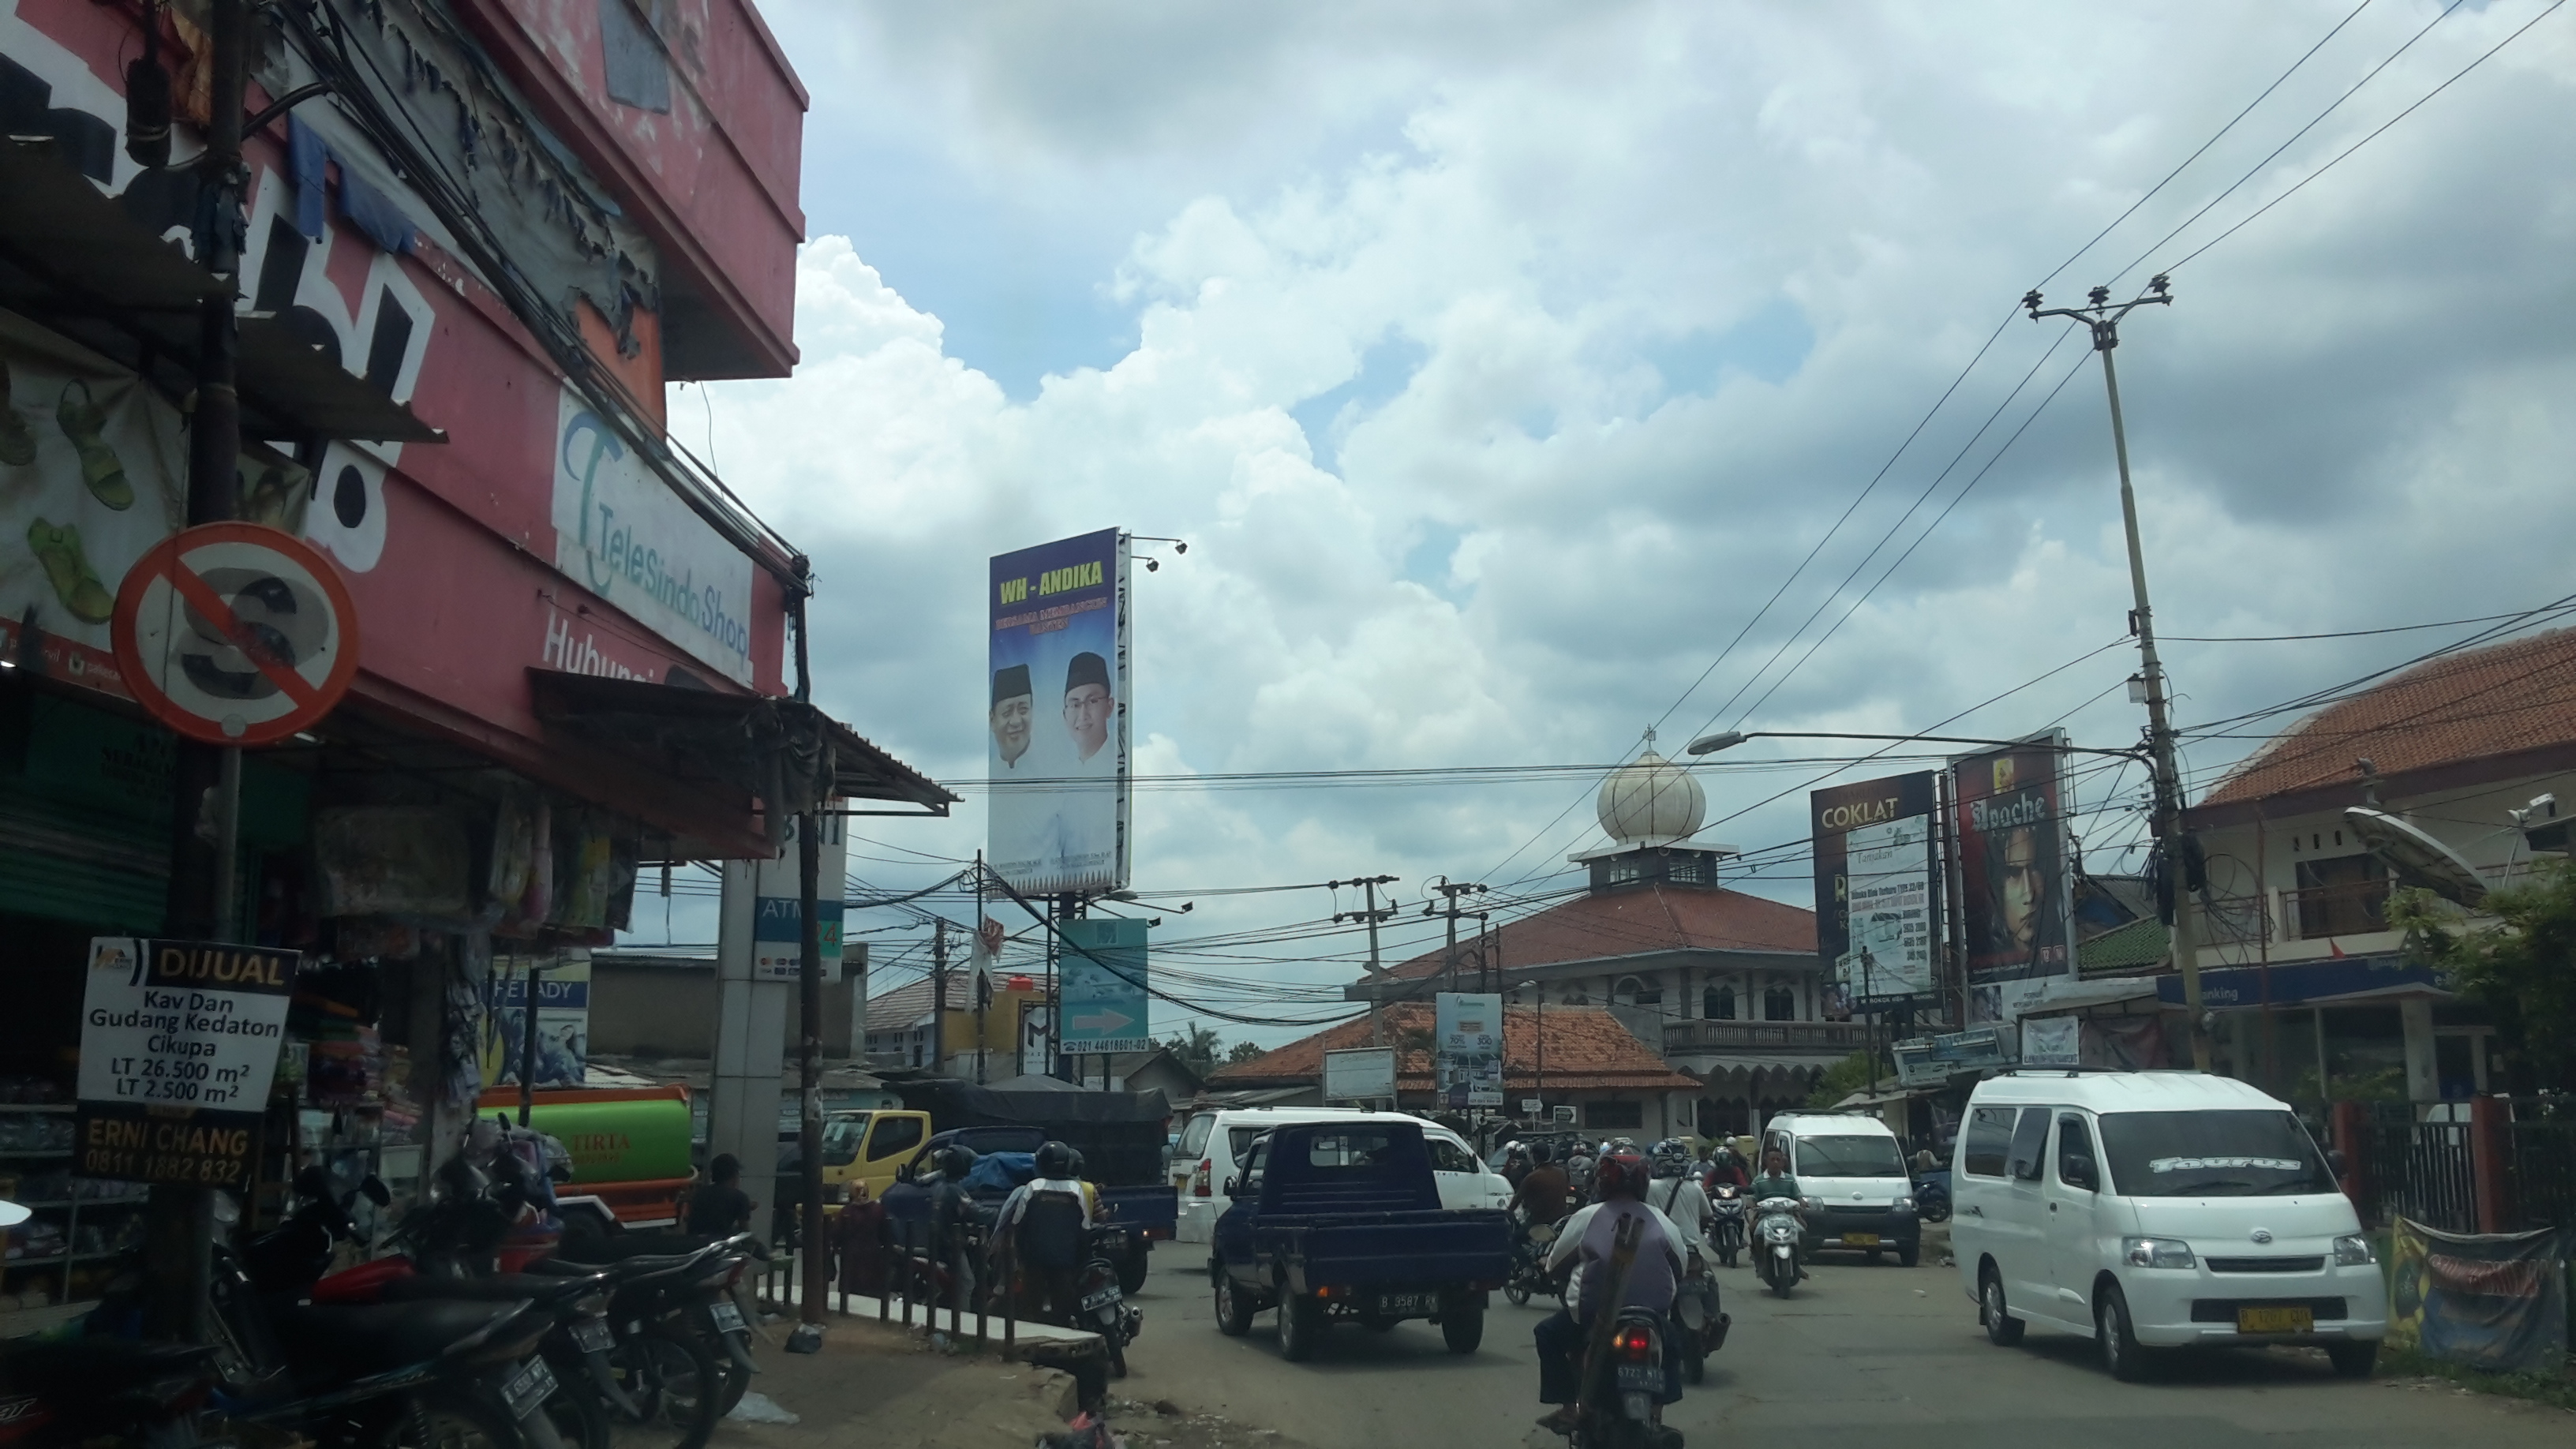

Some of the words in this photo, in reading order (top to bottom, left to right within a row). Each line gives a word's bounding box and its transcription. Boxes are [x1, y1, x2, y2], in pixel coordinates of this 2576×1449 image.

[600, 501, 699, 622] TeleSindo
[702, 585, 748, 672] Shop
[1001, 577, 1028, 605] WH
[1039, 561, 1103, 596] ANDIKA
[1822, 797, 1898, 829] COKLAT
[1971, 792, 2045, 832] Apache
[160, 946, 284, 987] DIJUAL
[144, 991, 184, 1009] Kav
[189, 993, 233, 1013] Dan
[2201, 987, 2238, 1001] anking
[90, 1009, 179, 1035] Gudang
[185, 1013, 279, 1039] Kedaton
[148, 1035, 215, 1060] Cikupa
[1078, 1040, 1092, 1052] 021
[111, 1058, 135, 1075] LT
[140, 1058, 209, 1080] 26.500
[117, 1078, 140, 1095] LT
[144, 1080, 198, 1100] 2.500
[88, 1118, 148, 1148] ERNI
[156, 1121, 249, 1156] CHANG
[574, 1134, 631, 1151] TIRTA
[85, 1150, 134, 1174] 0811
[198, 1159, 242, 1183] 832
[1381, 1297, 1387, 1308] B
[1395, 1295, 1419, 1307] 9587
